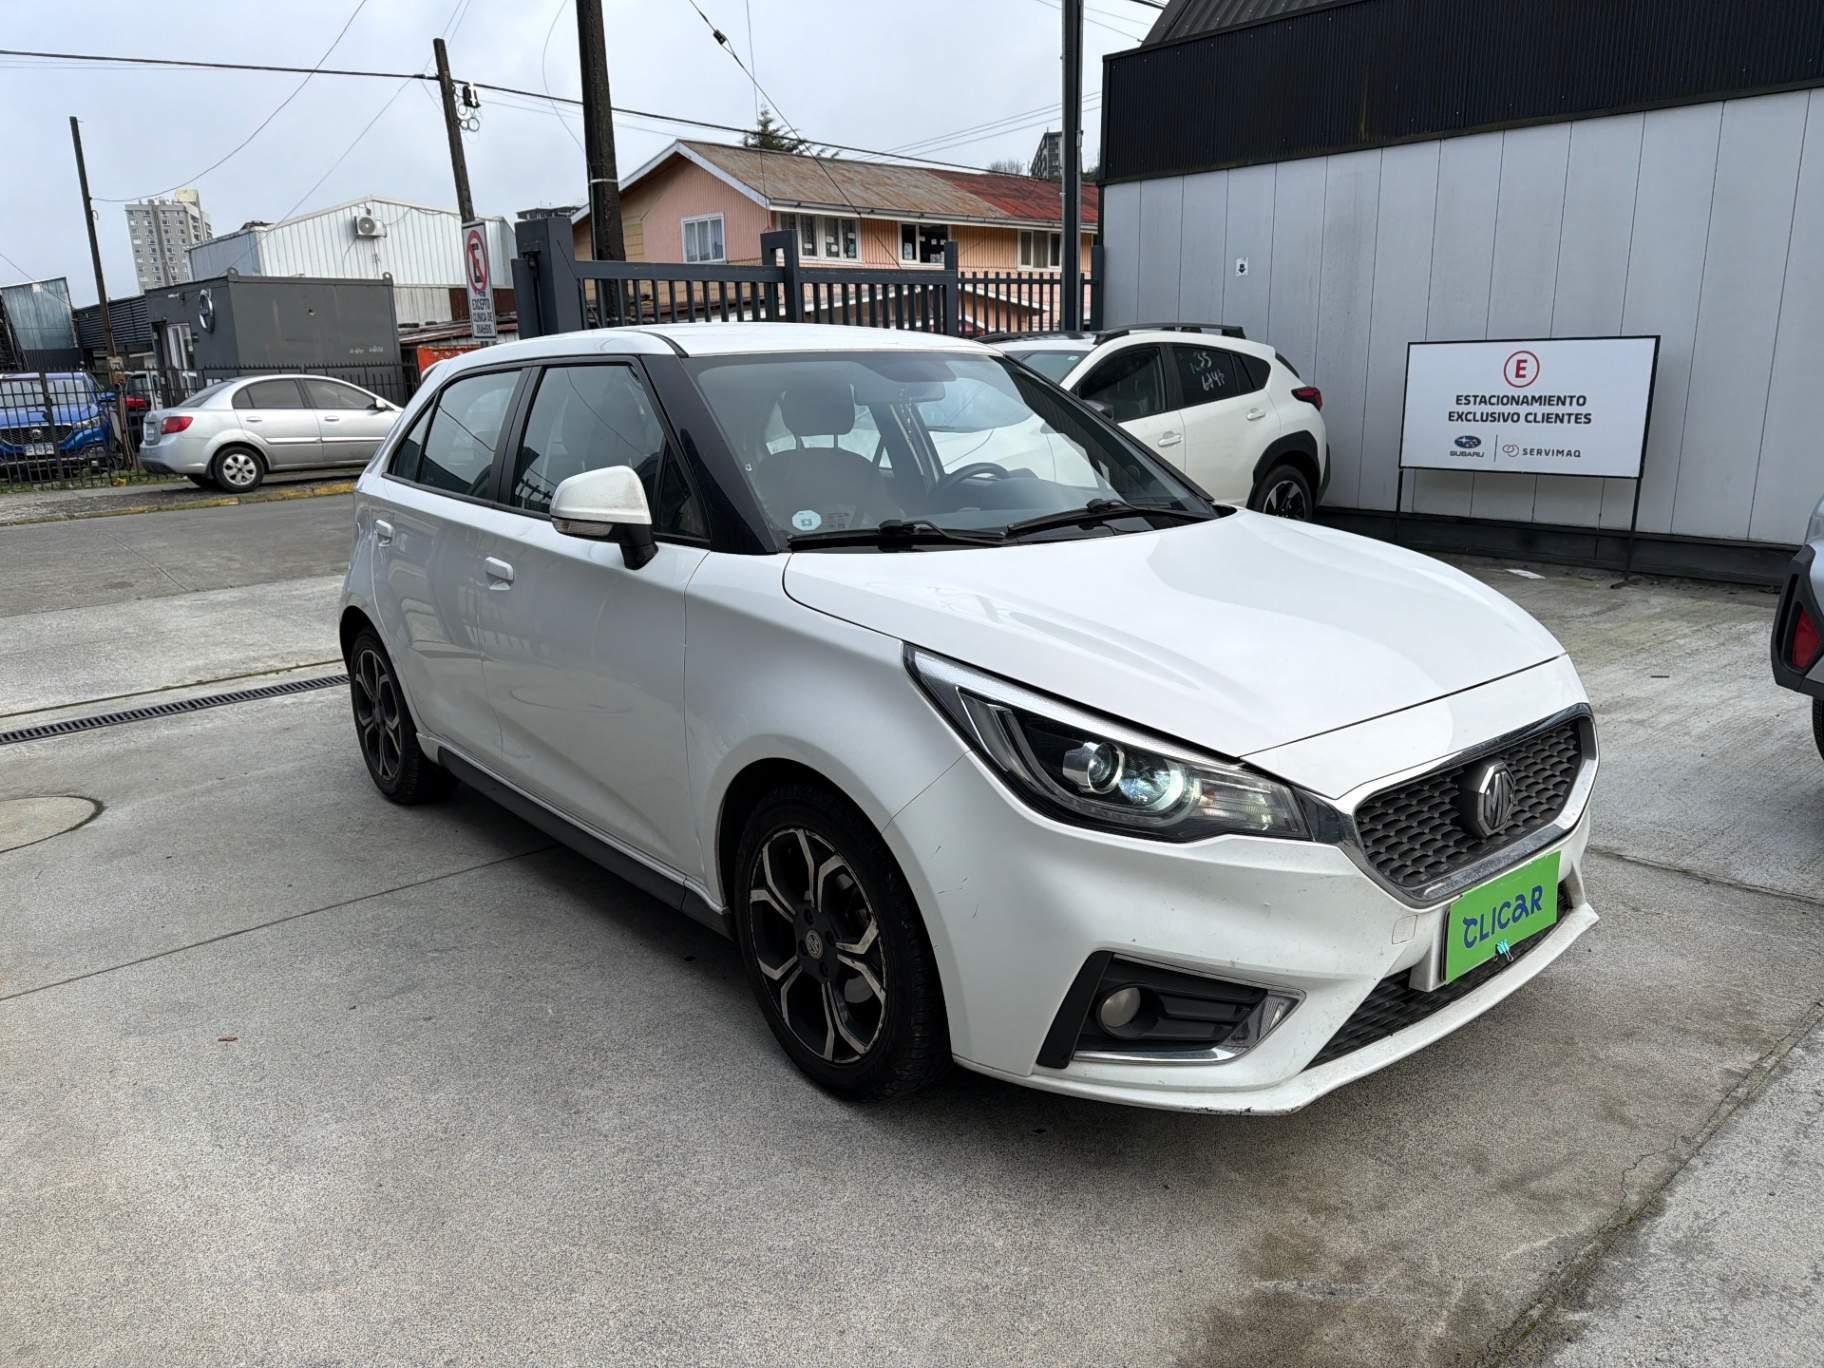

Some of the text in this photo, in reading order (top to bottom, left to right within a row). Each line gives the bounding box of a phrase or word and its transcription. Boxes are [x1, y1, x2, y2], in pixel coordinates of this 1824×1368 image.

[1514, 359, 1528, 379] E
[1455, 394, 1587, 407] ESTACIONAMIENTO
[1448, 411, 1592, 425] EXCLUSIVO CLIENTES
[1449, 450, 1485, 458] SUBARU
[1522, 447, 1582, 459] SERVIMAQ
